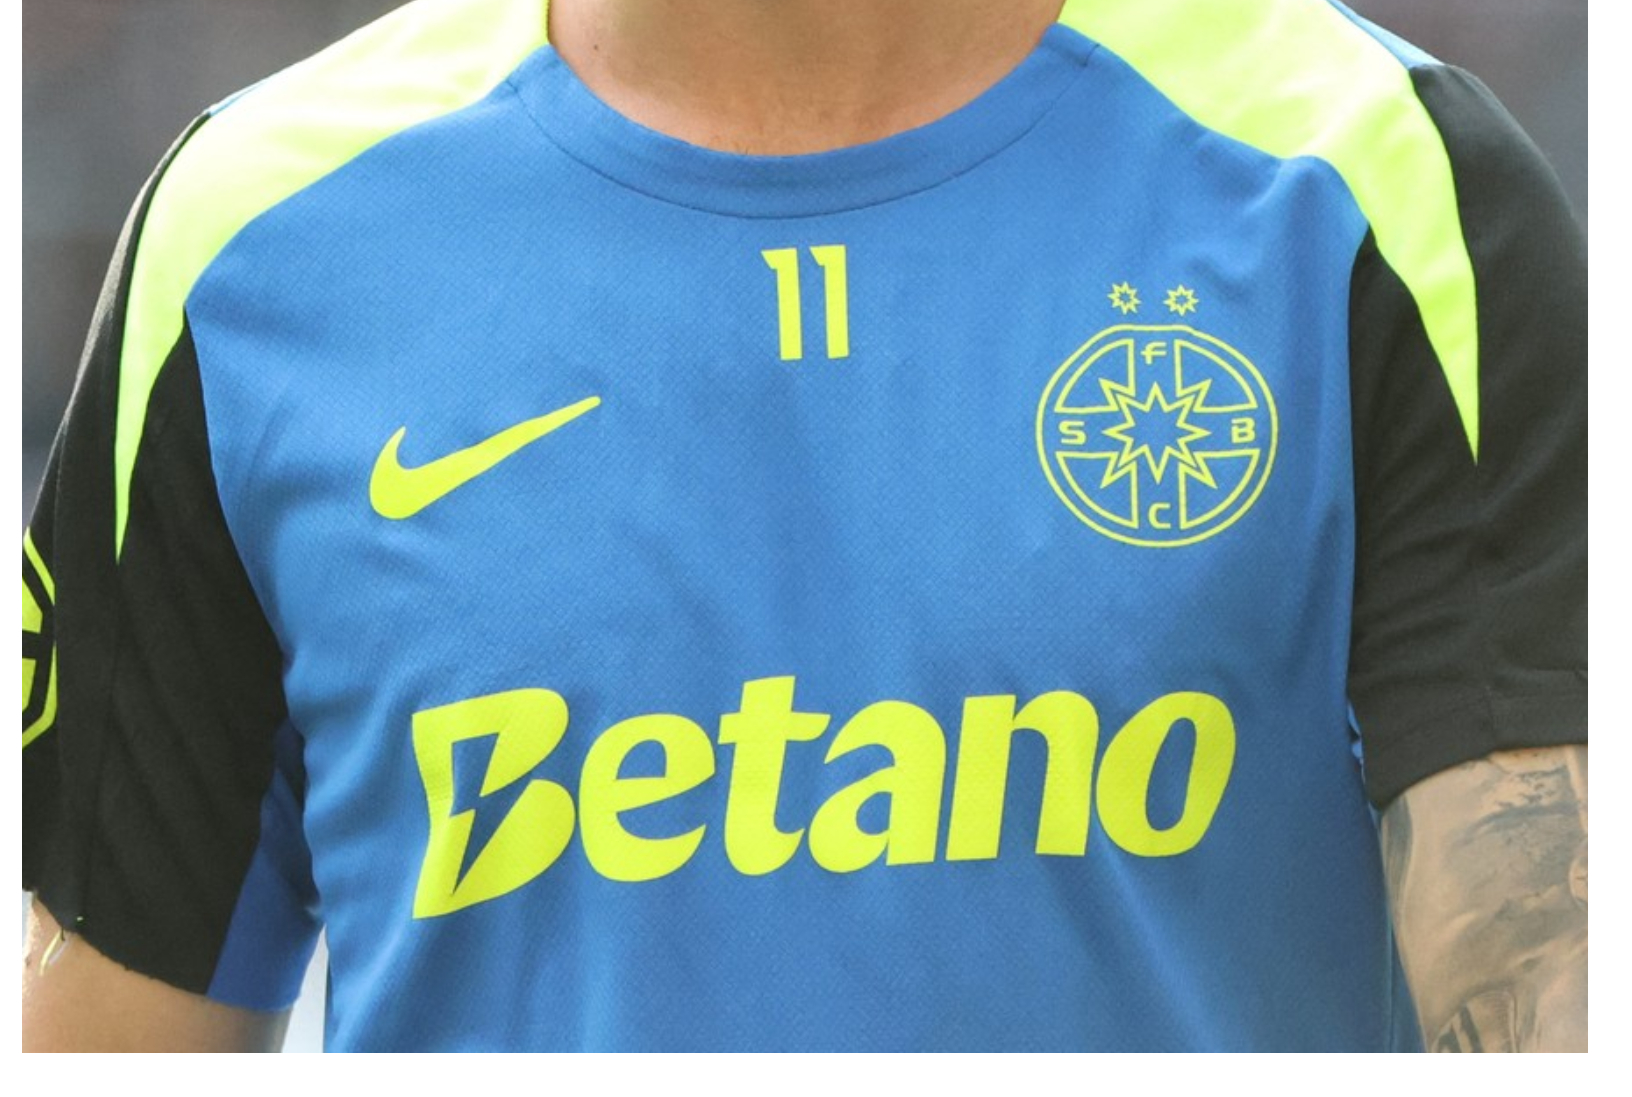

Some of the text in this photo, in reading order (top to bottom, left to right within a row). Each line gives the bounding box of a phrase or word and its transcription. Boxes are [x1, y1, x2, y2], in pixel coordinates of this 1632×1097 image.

[760, 244, 850, 361] 11
[1057, 419, 1087, 446] S
[1230, 416, 1257, 444] B
[1147, 502, 1172, 530] C
[411, 675, 1237, 920] Betano
